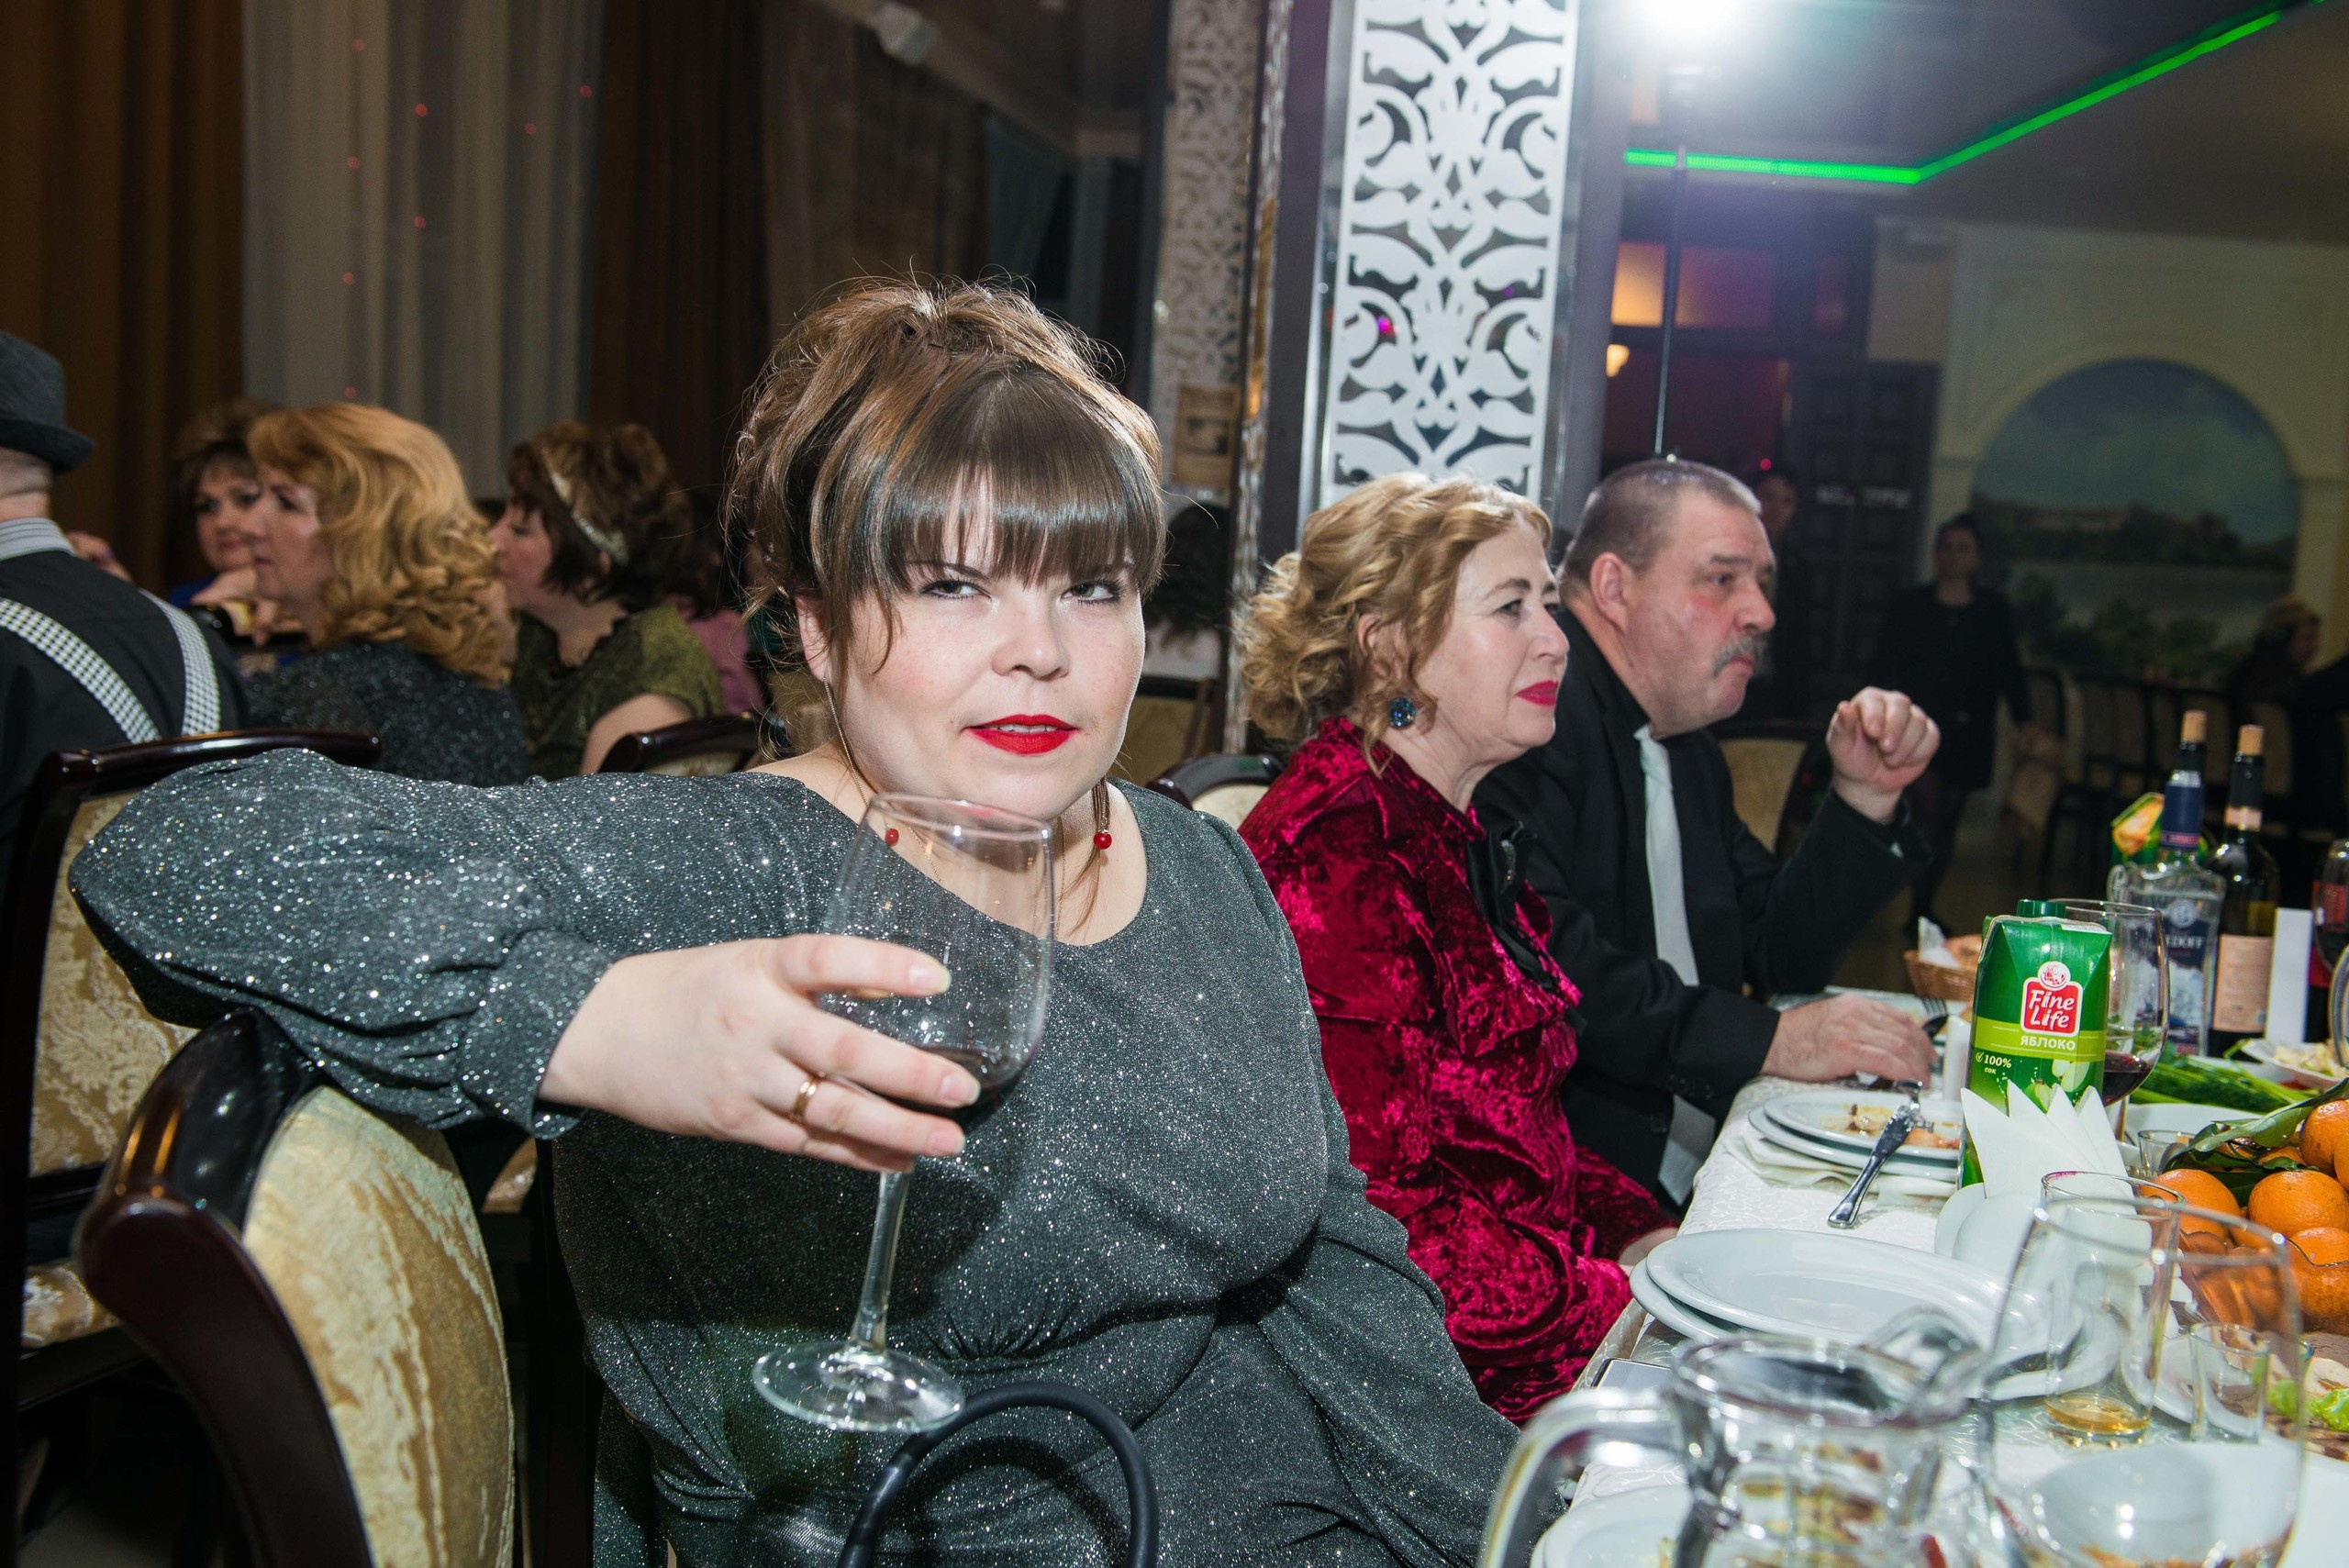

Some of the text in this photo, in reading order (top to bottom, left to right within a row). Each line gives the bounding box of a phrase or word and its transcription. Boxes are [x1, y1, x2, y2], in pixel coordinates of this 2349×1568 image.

[2029, 989, 2075, 1010] Fine
[2030, 1005, 2069, 1030] Life
[2020, 1035, 2076, 1051] ЯБЛОКО
[1984, 1054, 2012, 1069] 100%
[1984, 1067, 1997, 1075] сок
